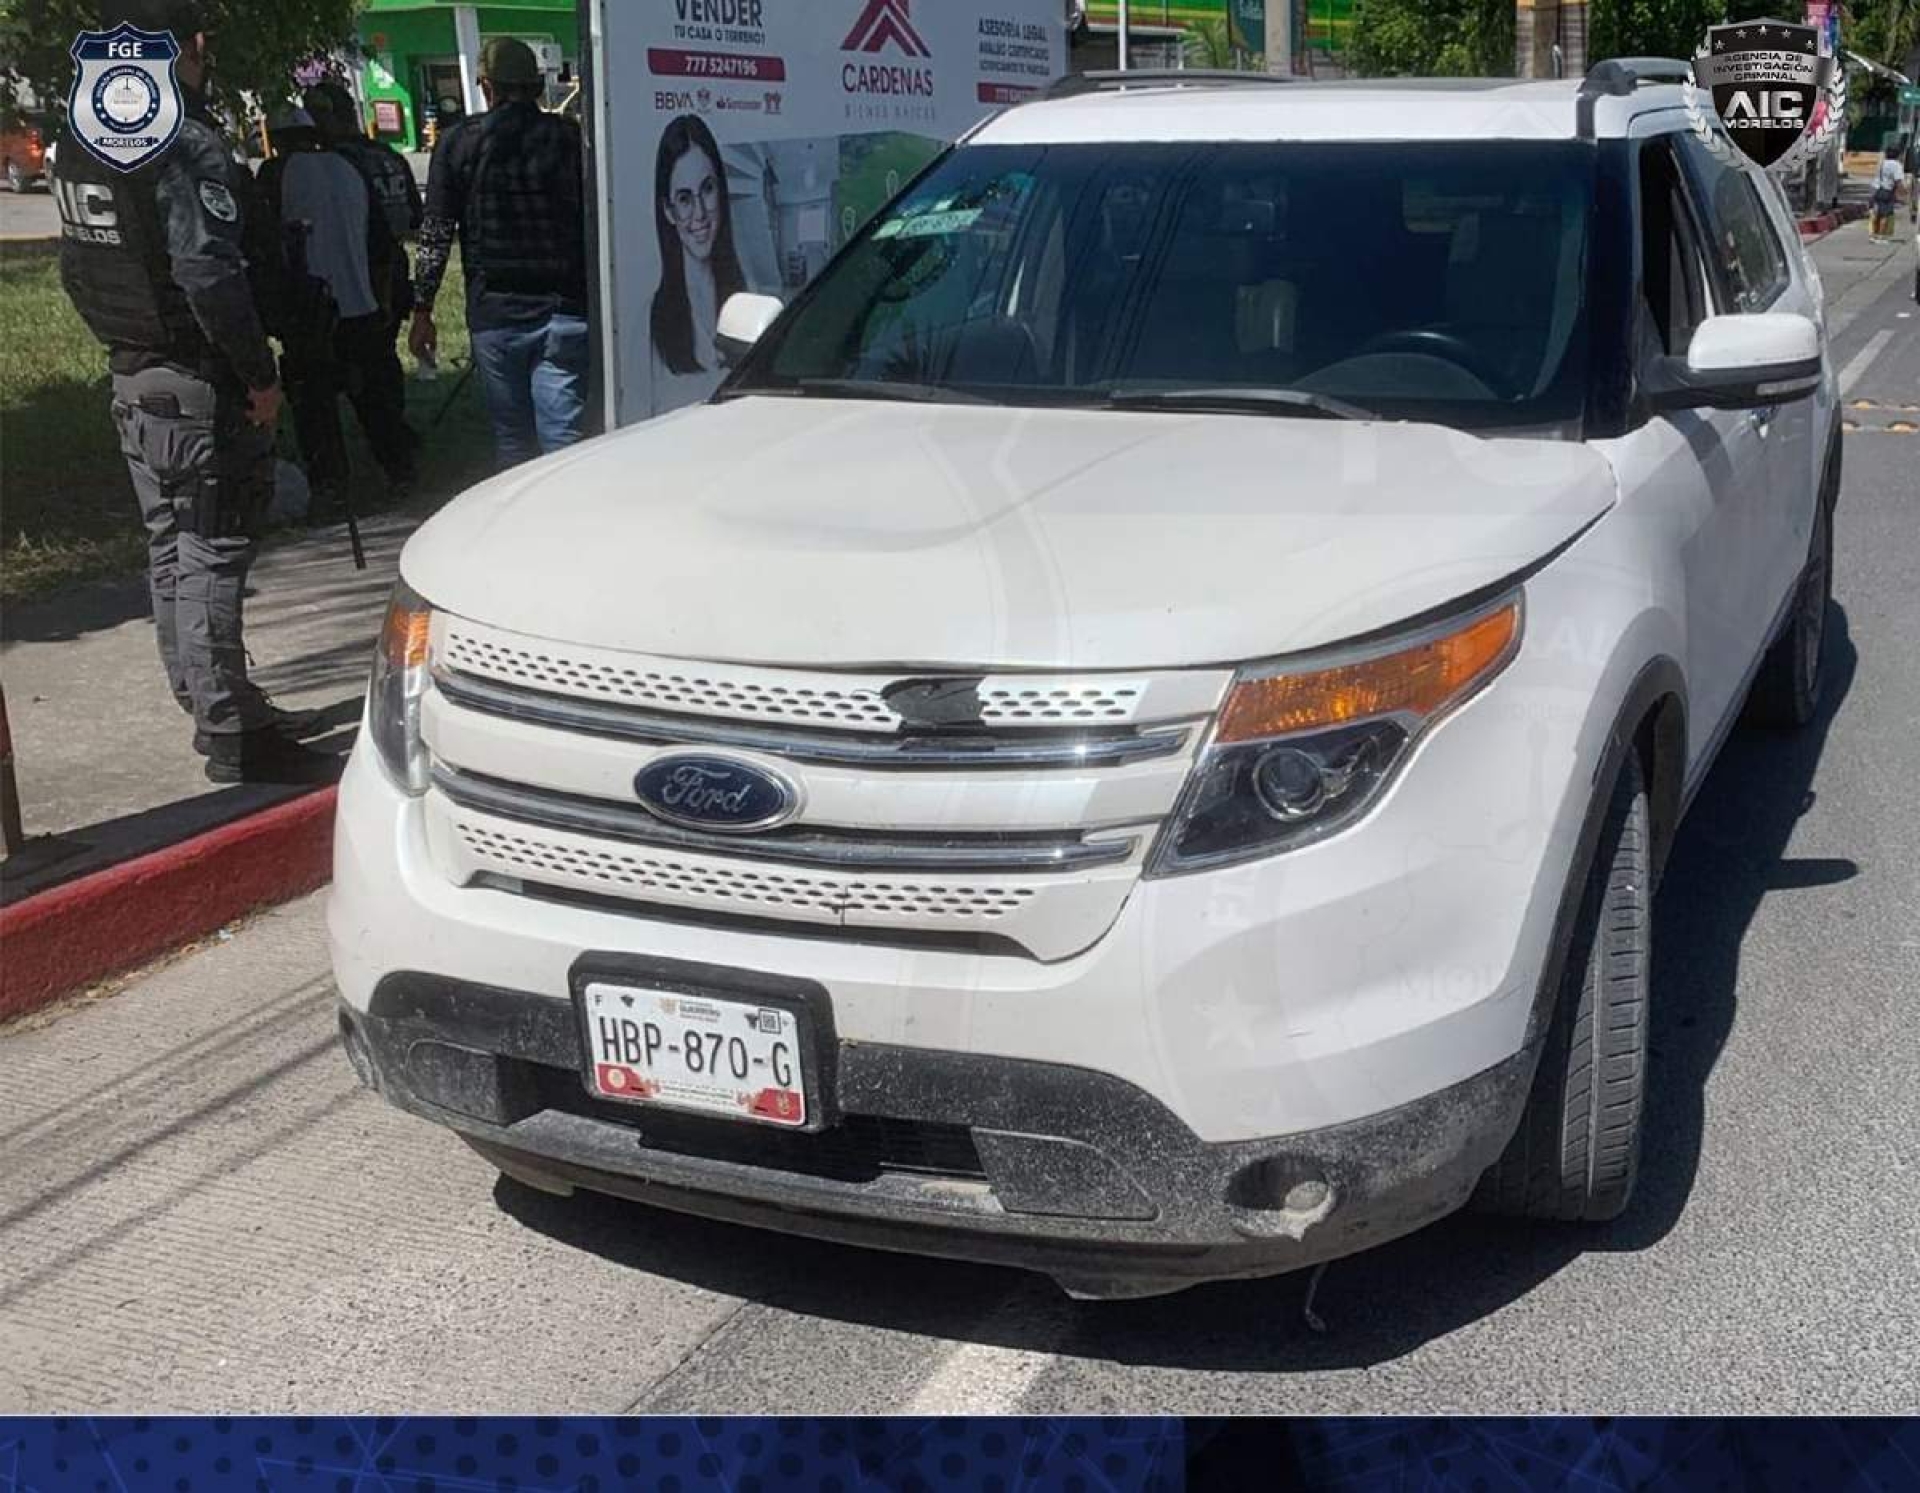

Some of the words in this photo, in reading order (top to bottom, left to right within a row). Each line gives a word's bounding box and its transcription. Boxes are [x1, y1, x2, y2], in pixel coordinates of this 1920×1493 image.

[674, 0, 763, 27] VENDER
[674, 25, 686, 38] TU
[687, 26, 712, 41] CASA
[684, 55, 707, 73] 777
[842, 63, 934, 97] CARDENAS
[655, 91, 694, 110] BBVA
[661, 765, 752, 814] Ford
[599, 1015, 792, 1088] HBP-870-G
